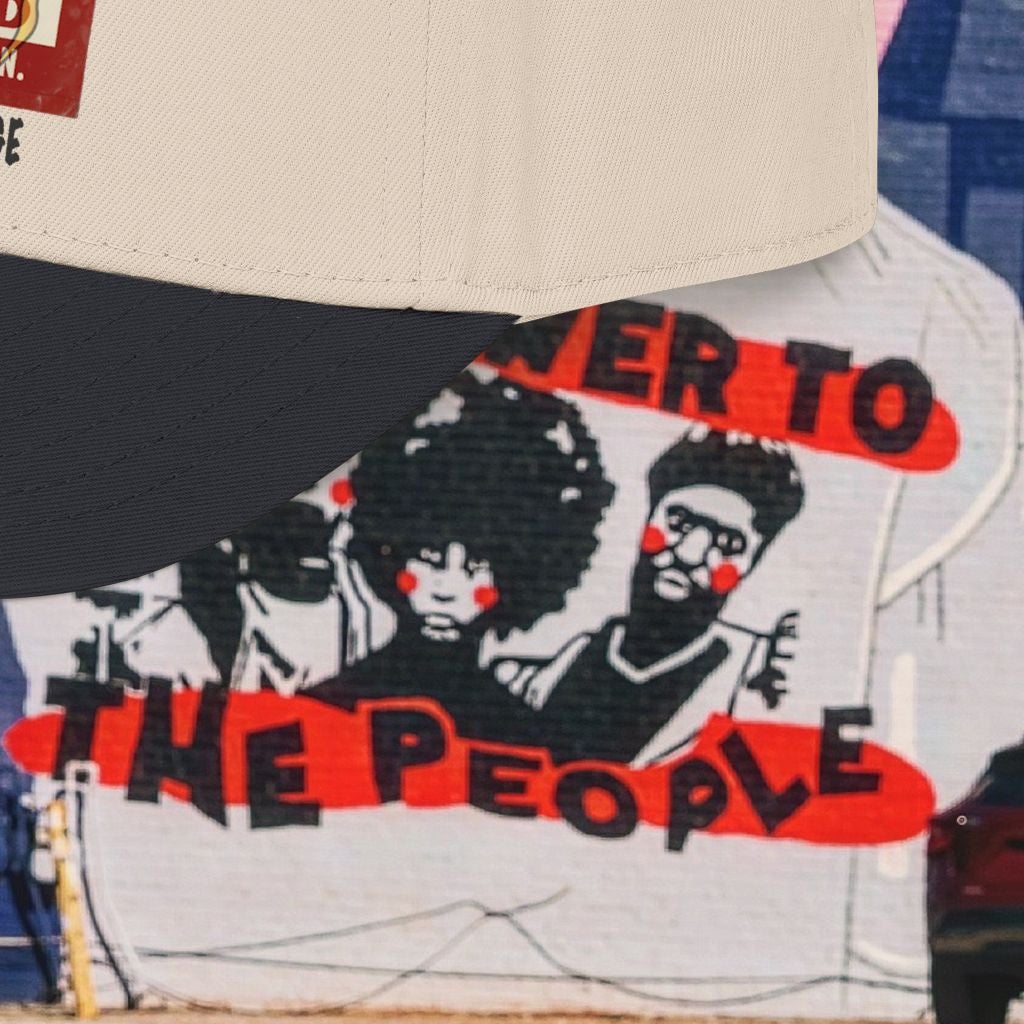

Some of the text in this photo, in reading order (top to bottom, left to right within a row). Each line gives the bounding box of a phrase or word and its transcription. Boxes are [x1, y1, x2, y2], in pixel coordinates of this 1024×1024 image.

[784, 339, 934, 455] TO
[45, 676, 882, 853] THE PEOPLE
